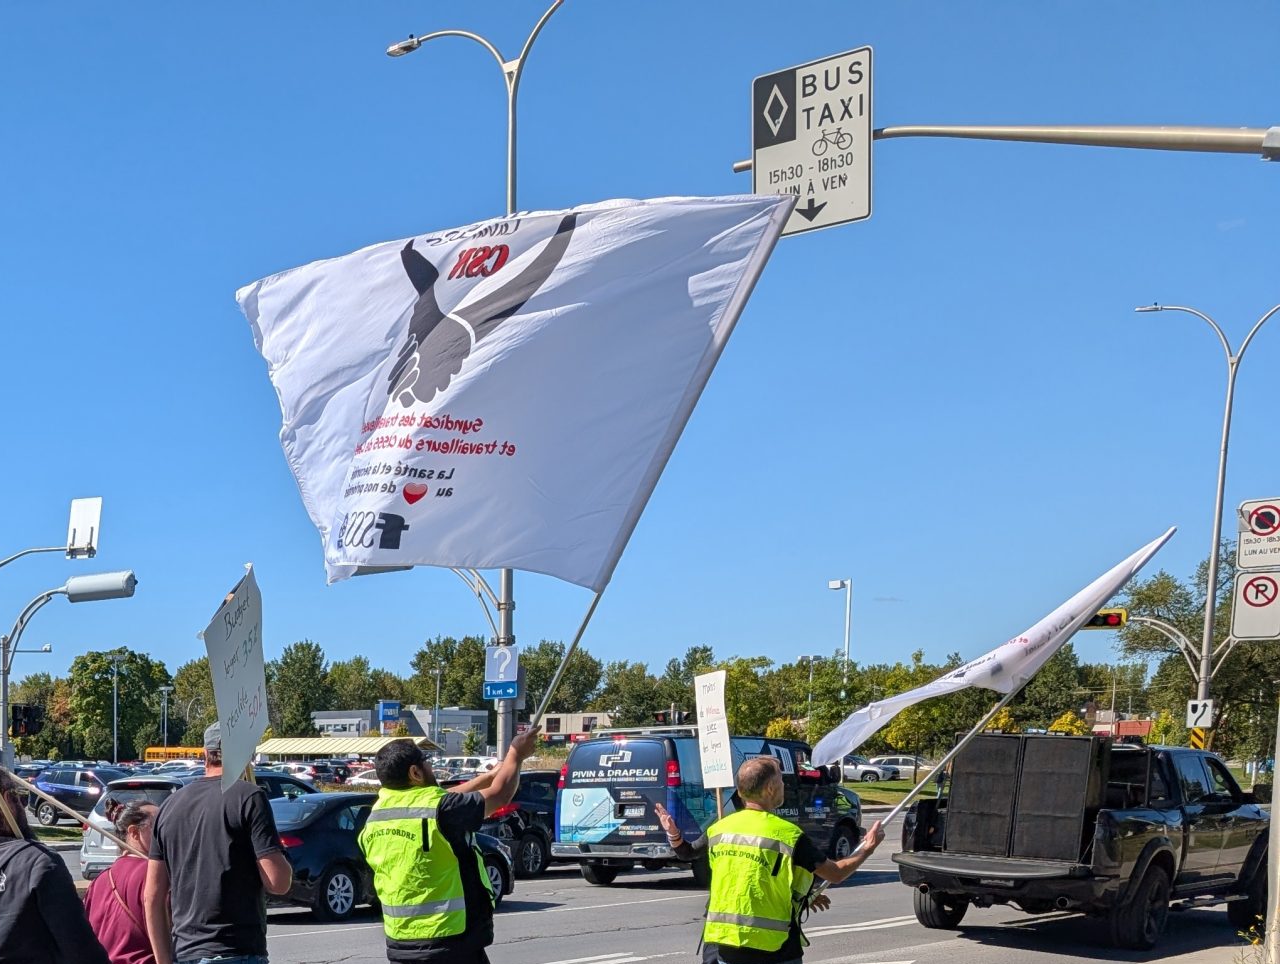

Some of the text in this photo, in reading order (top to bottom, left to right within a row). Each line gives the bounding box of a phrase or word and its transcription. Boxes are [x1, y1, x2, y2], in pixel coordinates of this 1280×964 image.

[802, 61, 864, 98] BUS
[802, 93, 864, 130] TAXI
[769, 164, 803, 184] 15h30
[818, 152, 853, 172] 18h30
[822, 173, 848, 191] VEN
[1243, 537, 1261, 545] 15h30
[224, 586, 250, 641] Budget
[485, 686, 491, 695] 1
[572, 770, 596, 778] PIVIN
[607, 769, 659, 777] DRAPEAU
[774, 808, 798, 816] RAPEAU
[386, 828, 416, 841] D'ORDRE
